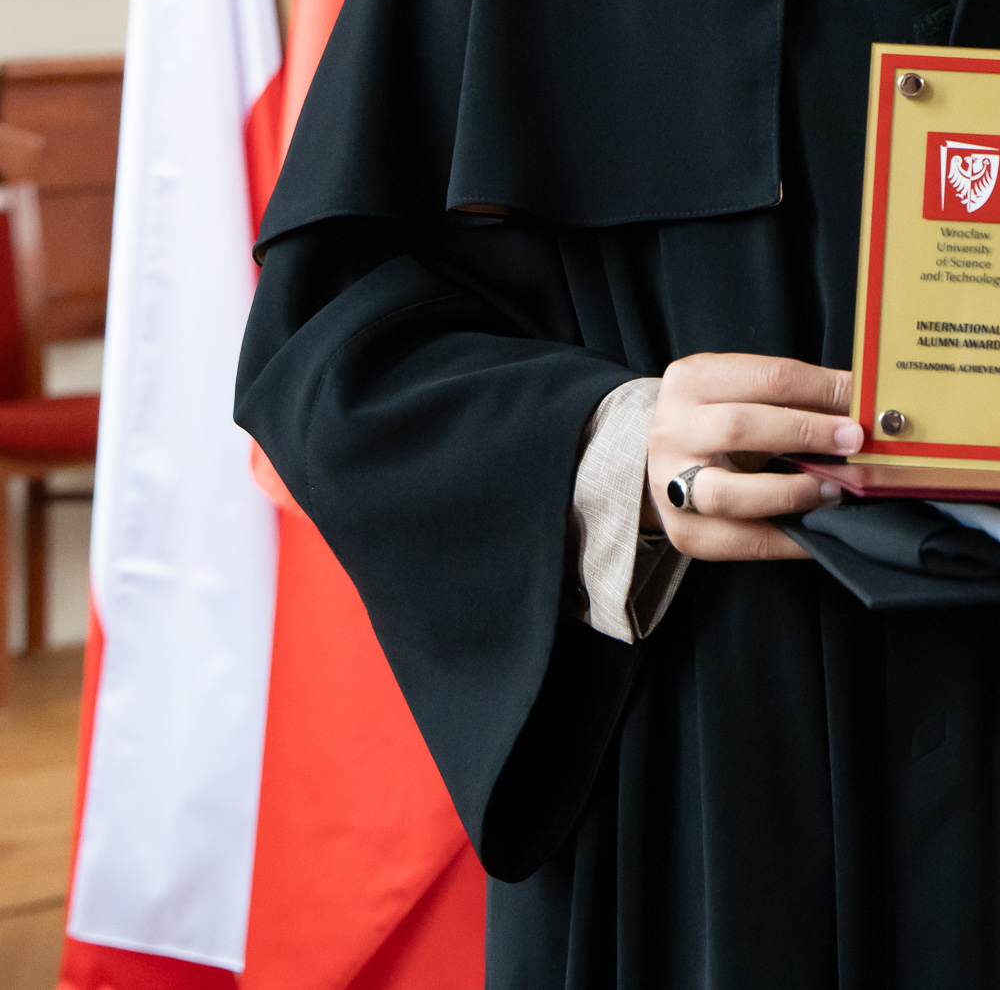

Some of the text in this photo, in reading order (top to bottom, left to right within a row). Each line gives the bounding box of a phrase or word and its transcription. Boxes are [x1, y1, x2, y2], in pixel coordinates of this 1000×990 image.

[936, 242, 992, 256] University
[935, 256, 992, 269] of Science
[919, 270, 944, 282] and
[917, 336, 959, 348] ALUMNI
[896, 361, 956, 372] OUTSTANDING
